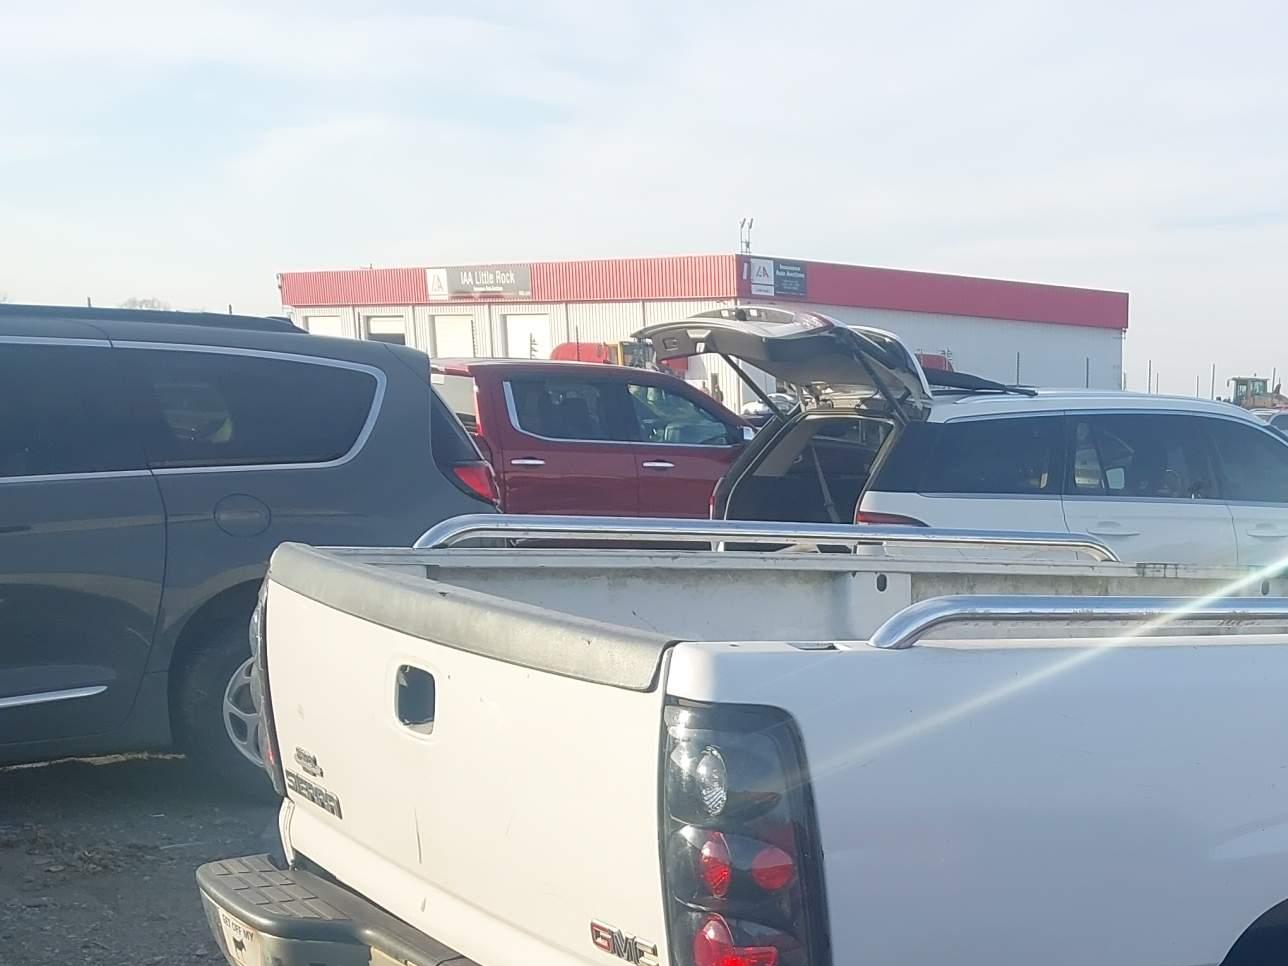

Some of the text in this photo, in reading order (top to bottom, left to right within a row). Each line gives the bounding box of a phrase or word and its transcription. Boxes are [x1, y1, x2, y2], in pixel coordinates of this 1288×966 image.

[460, 271, 474, 285] IAA
[474, 270, 494, 285] Little
[495, 270, 516, 284] Rock
[285, 769, 343, 820] SIERRA
[243, 928, 254, 942] MY
